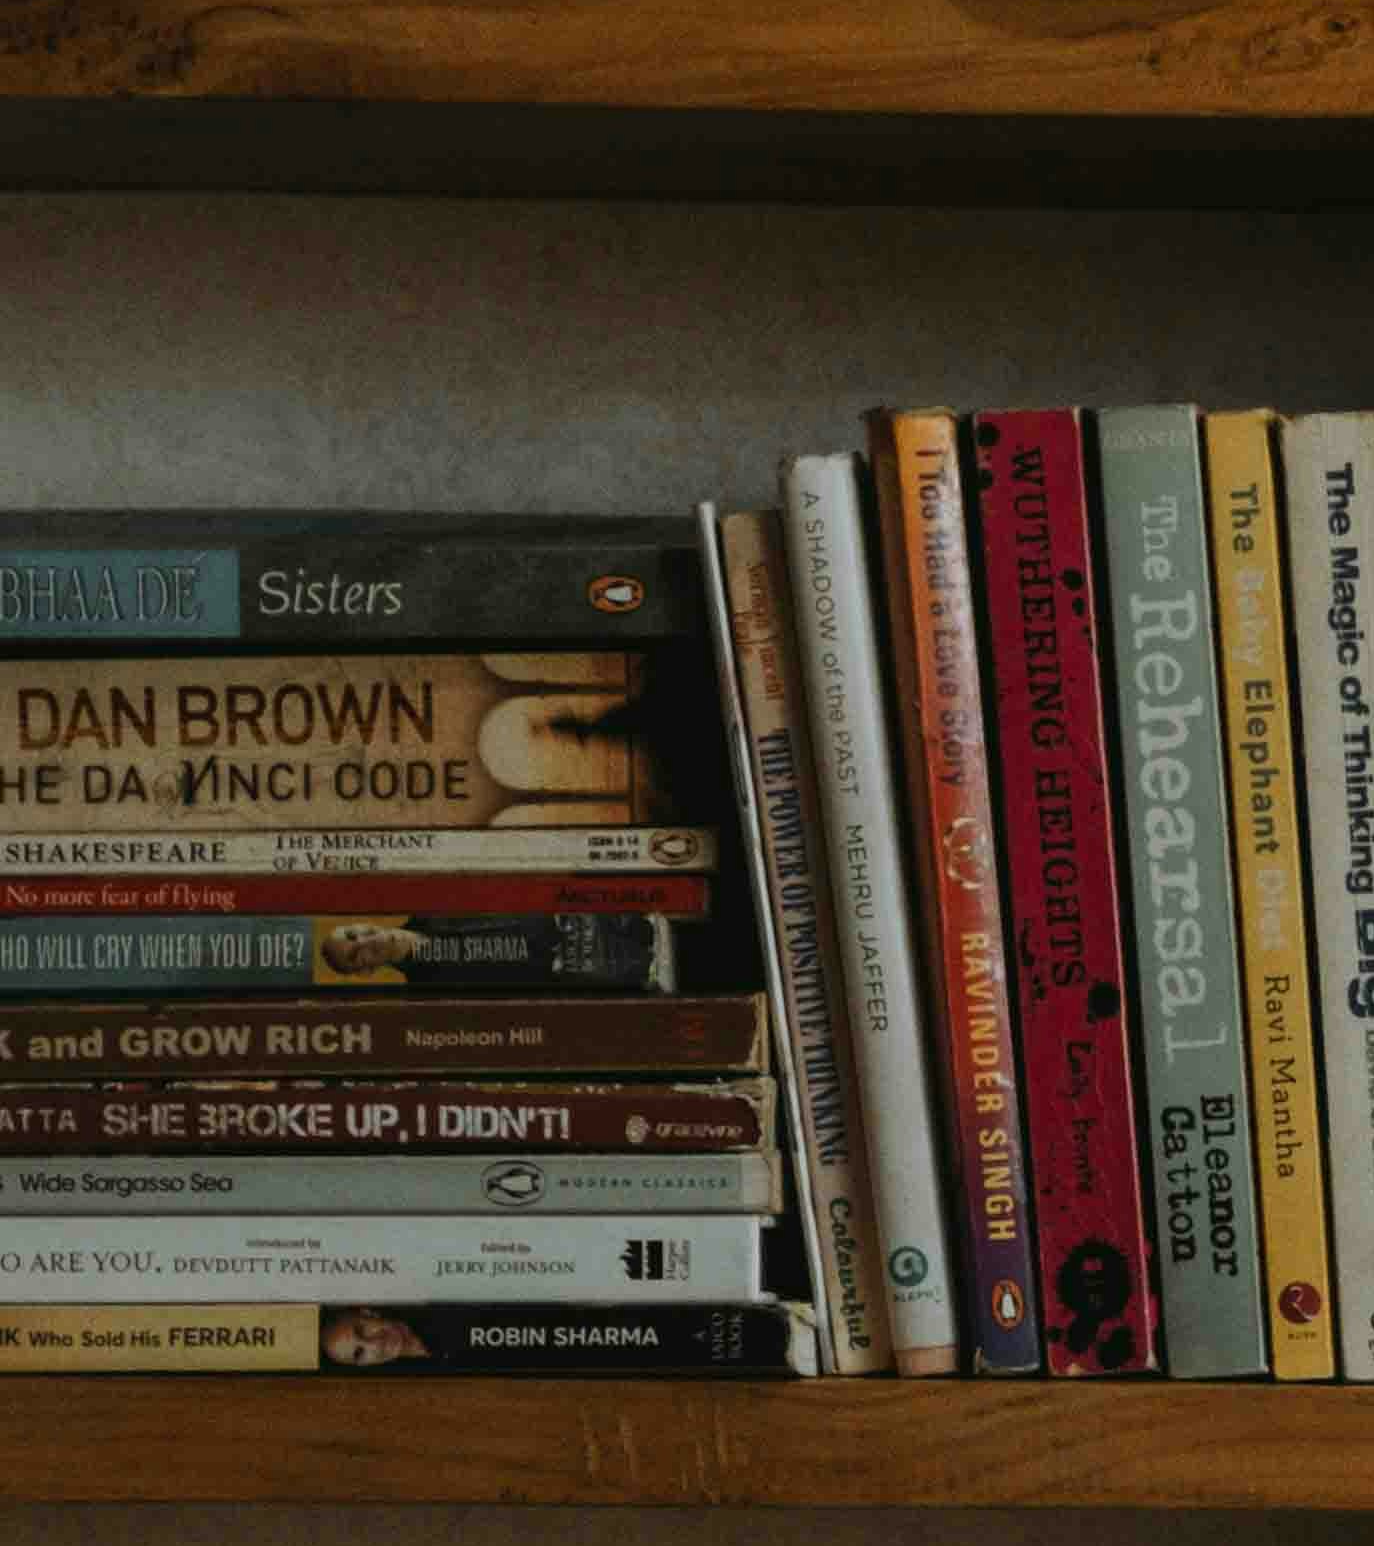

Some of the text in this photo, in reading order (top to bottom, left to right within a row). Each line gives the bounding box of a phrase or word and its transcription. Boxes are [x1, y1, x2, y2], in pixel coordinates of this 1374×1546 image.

[257, 569, 402, 616] Sisters
[17, 682, 434, 749] DAN BROWN
[83, 759, 469, 803] DA VINCI CODE
[1128, 496, 1226, 1064] The Rehearsal
[5, 841, 228, 864] SHAKESPEARE
[26, 1023, 544, 1061] and GROW RICH Napoleon Hill
[960, 932, 1016, 1242] RAVINDER SINGH
[19, 1171, 233, 1197] Wide Sargasso Sea
[469, 1324, 659, 1349] ROBIN SHARMA
